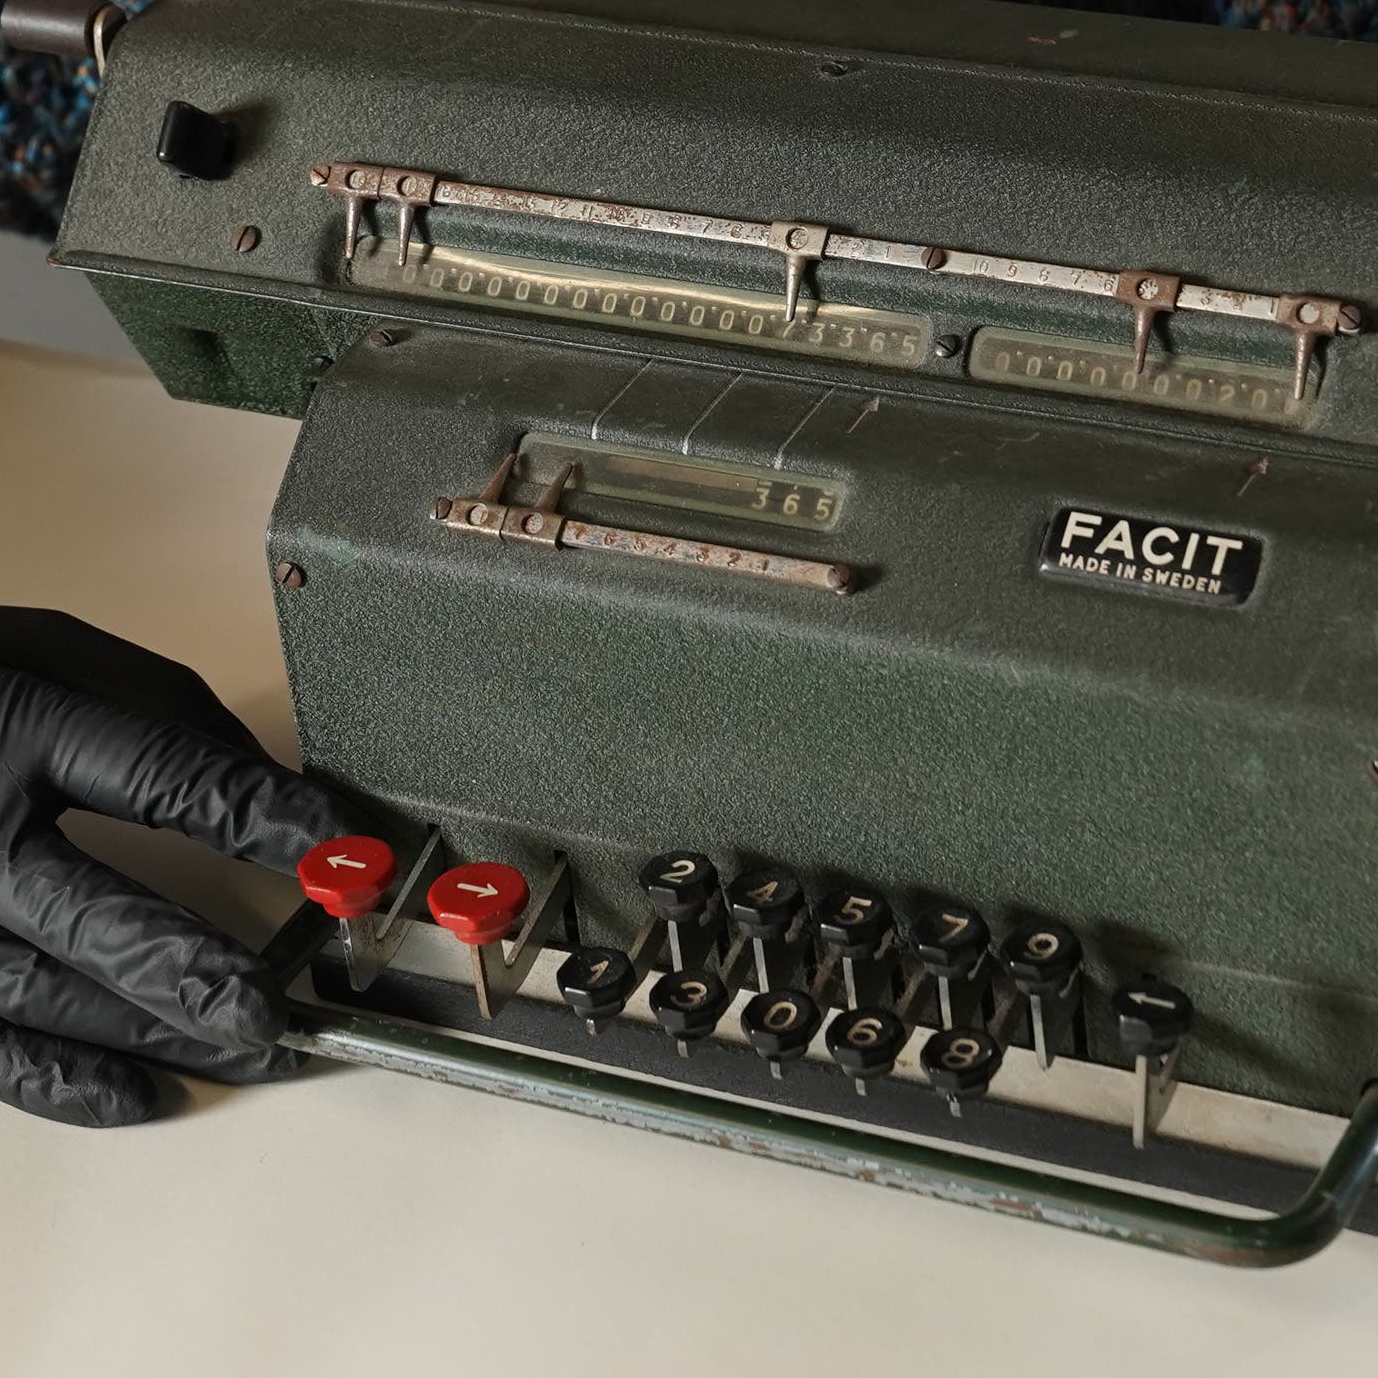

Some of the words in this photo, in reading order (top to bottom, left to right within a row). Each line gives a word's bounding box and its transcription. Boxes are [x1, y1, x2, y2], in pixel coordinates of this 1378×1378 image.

[974, 259, 989, 273] 10
[1007, 263, 1018, 278] 9
[751, 487, 832, 521] 365
[1060, 511, 1243, 575] FACIT
[1058, 552, 1111, 575] MADE
[1116, 563, 1137, 580] IN
[1141, 568, 1222, 594] SWEDEN
[659, 859, 696, 884] 2
[746, 880, 779, 904] 4
[833, 895, 872, 924] 5
[938, 912, 968, 943] 7
[1025, 932, 1059, 960] 9
[588, 959, 610, 985] 1
[672, 980, 708, 1007] 3
[763, 1001, 798, 1030] 0
[847, 1017, 884, 1046] 6
[941, 1037, 980, 1069] 8
